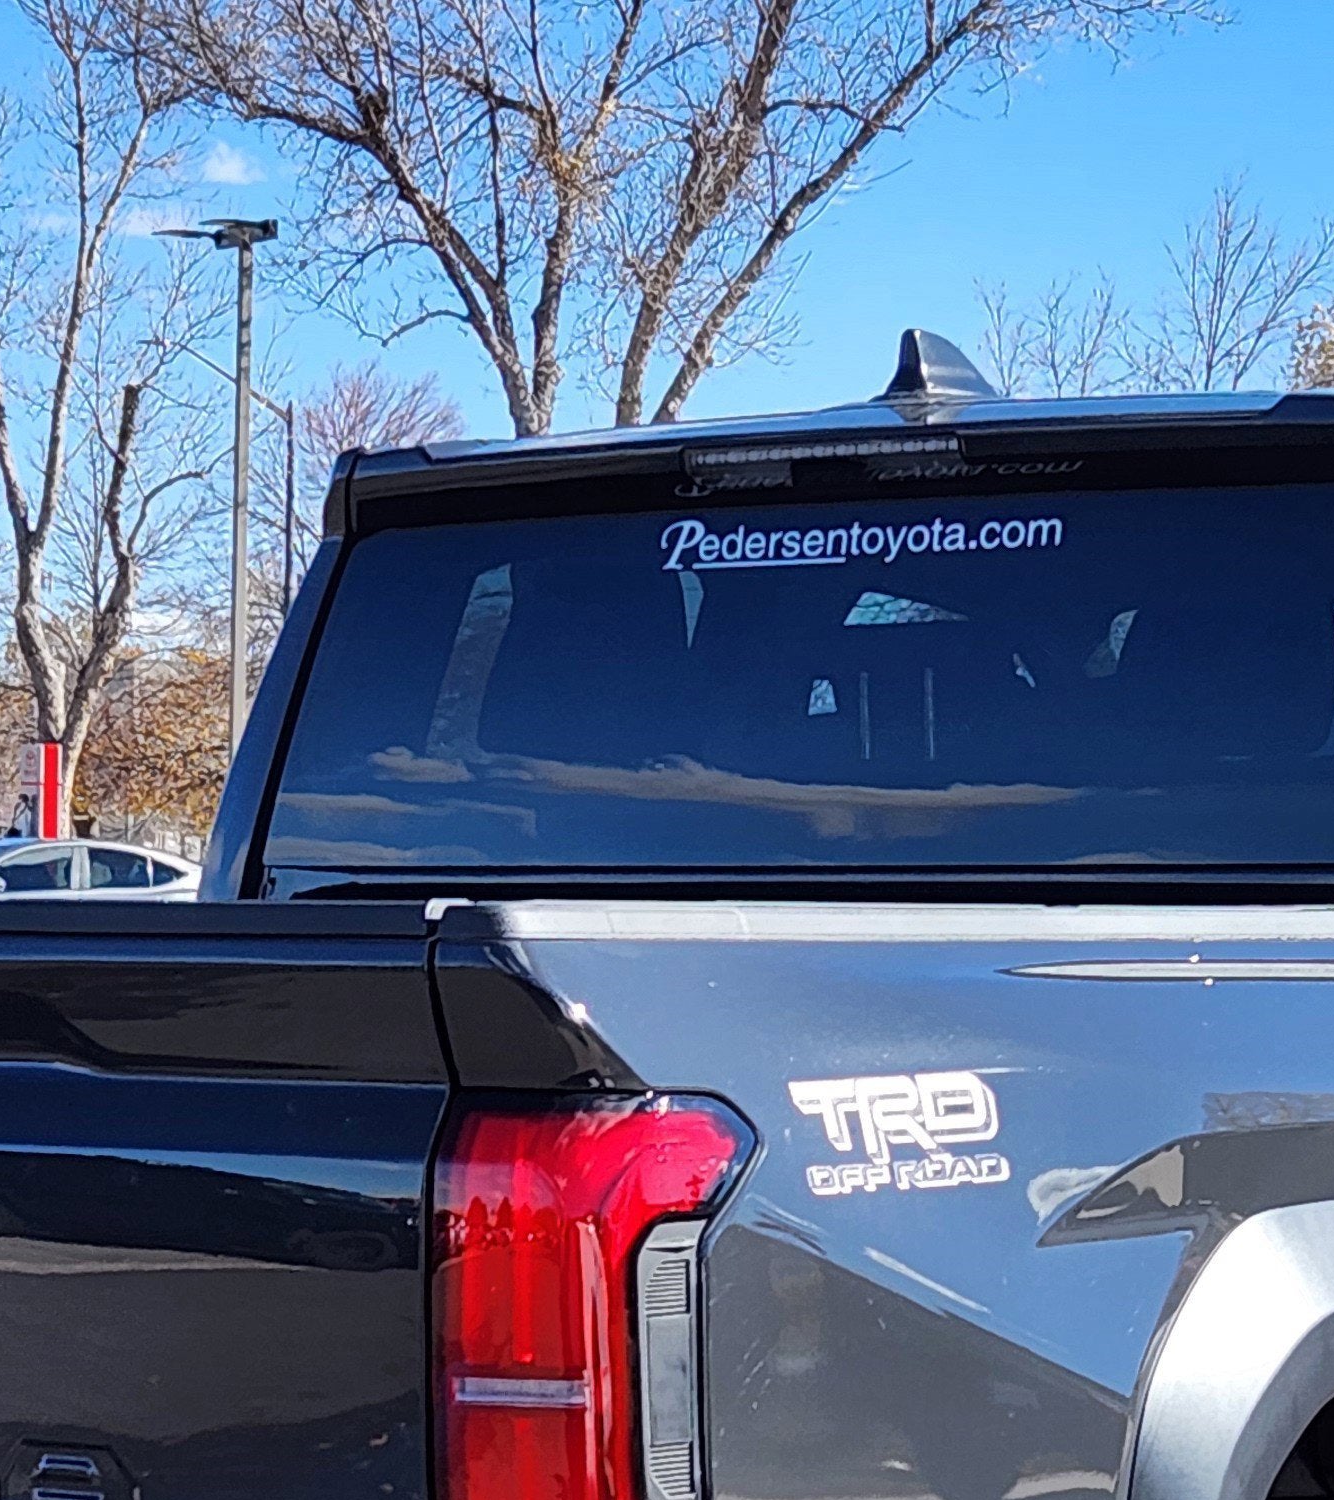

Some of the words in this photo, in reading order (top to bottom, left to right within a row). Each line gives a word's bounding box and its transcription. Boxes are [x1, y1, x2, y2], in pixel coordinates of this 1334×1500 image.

[660, 516, 1063, 571] Pedersentoyota.com
[787, 1070, 999, 1165] TRD
[805, 1164, 892, 1196] OFF
[892, 1152, 1011, 1190] ROAD
